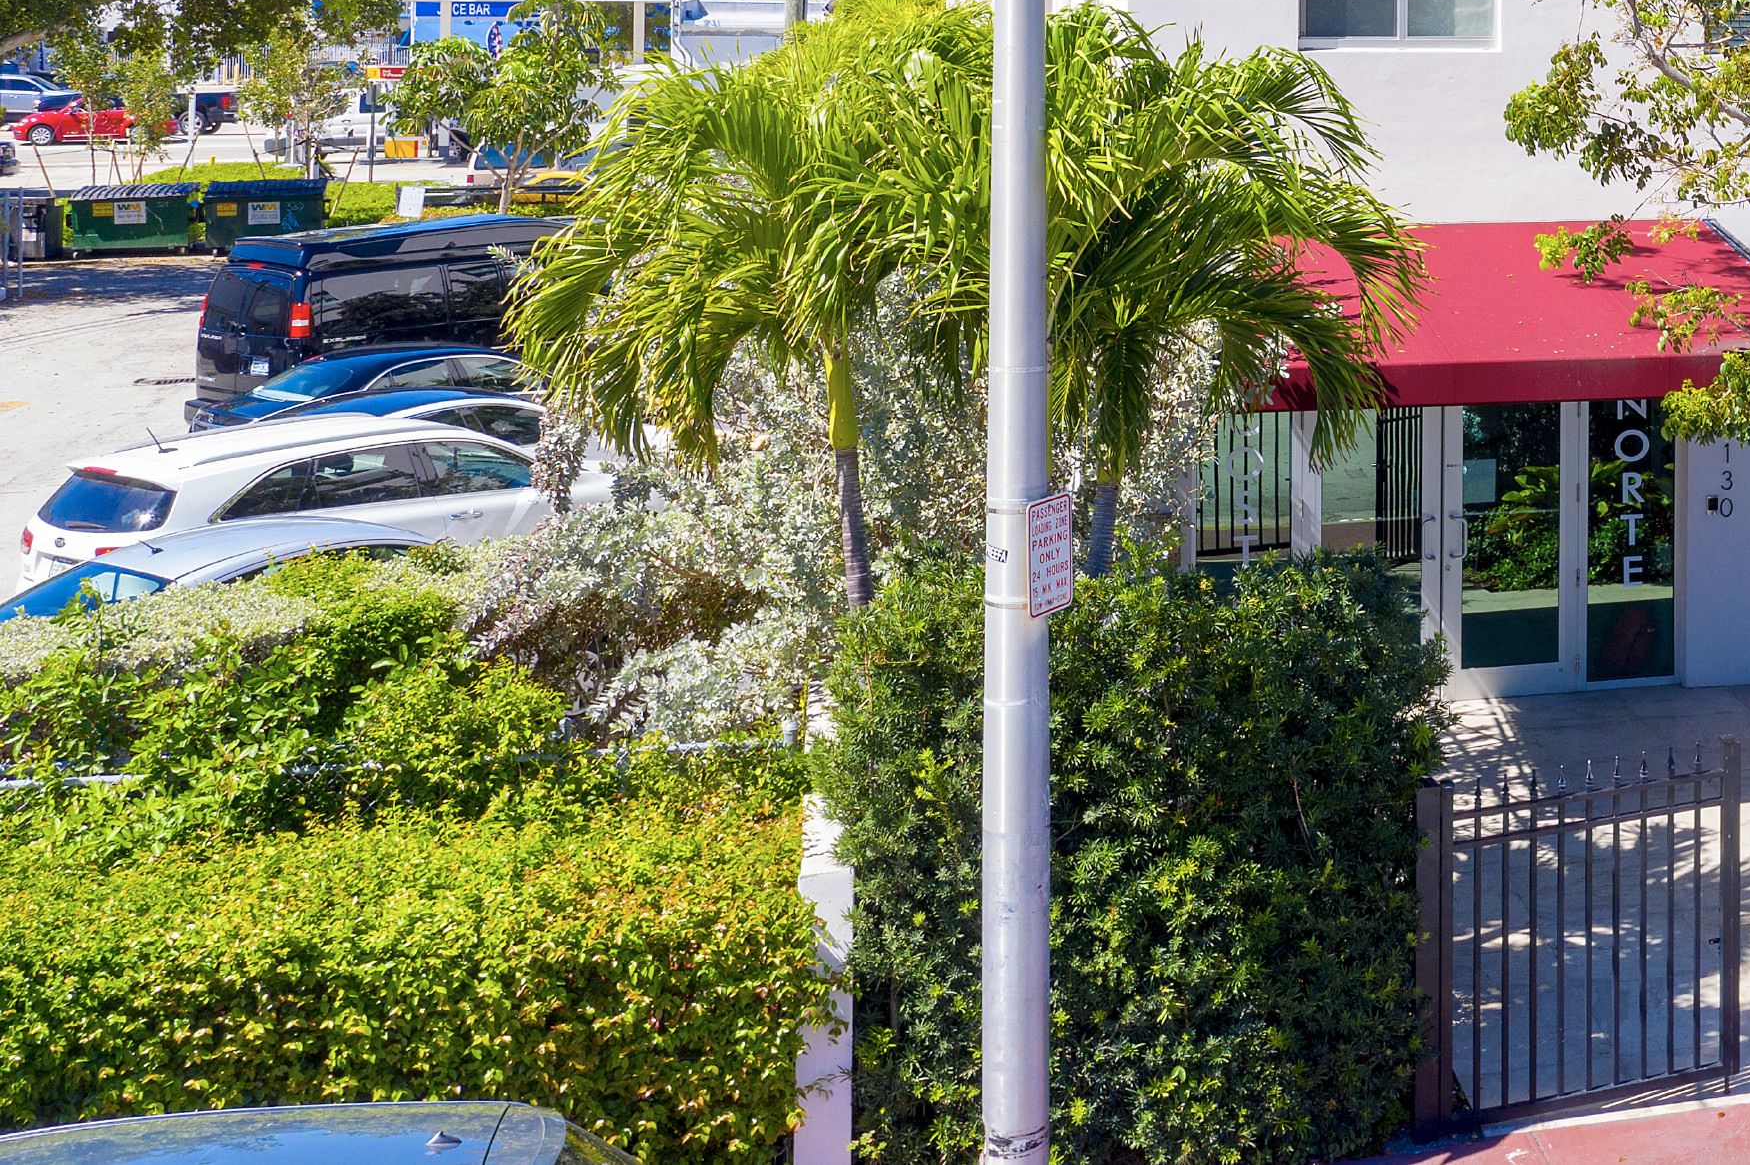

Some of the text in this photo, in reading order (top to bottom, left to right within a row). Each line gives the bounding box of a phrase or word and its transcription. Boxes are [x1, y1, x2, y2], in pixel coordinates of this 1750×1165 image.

[469, 3, 490, 15] BAR
[1614, 399, 1650, 587] NORTE
[1031, 499, 1068, 522] PASSENGER
[1055, 514, 1068, 529] ZONE
[1032, 530, 1068, 551] PARKING
[1039, 547, 1061, 564] ONLY
[1032, 560, 1069, 583] 24 HOURS
[1032, 587, 1039, 599] 15
